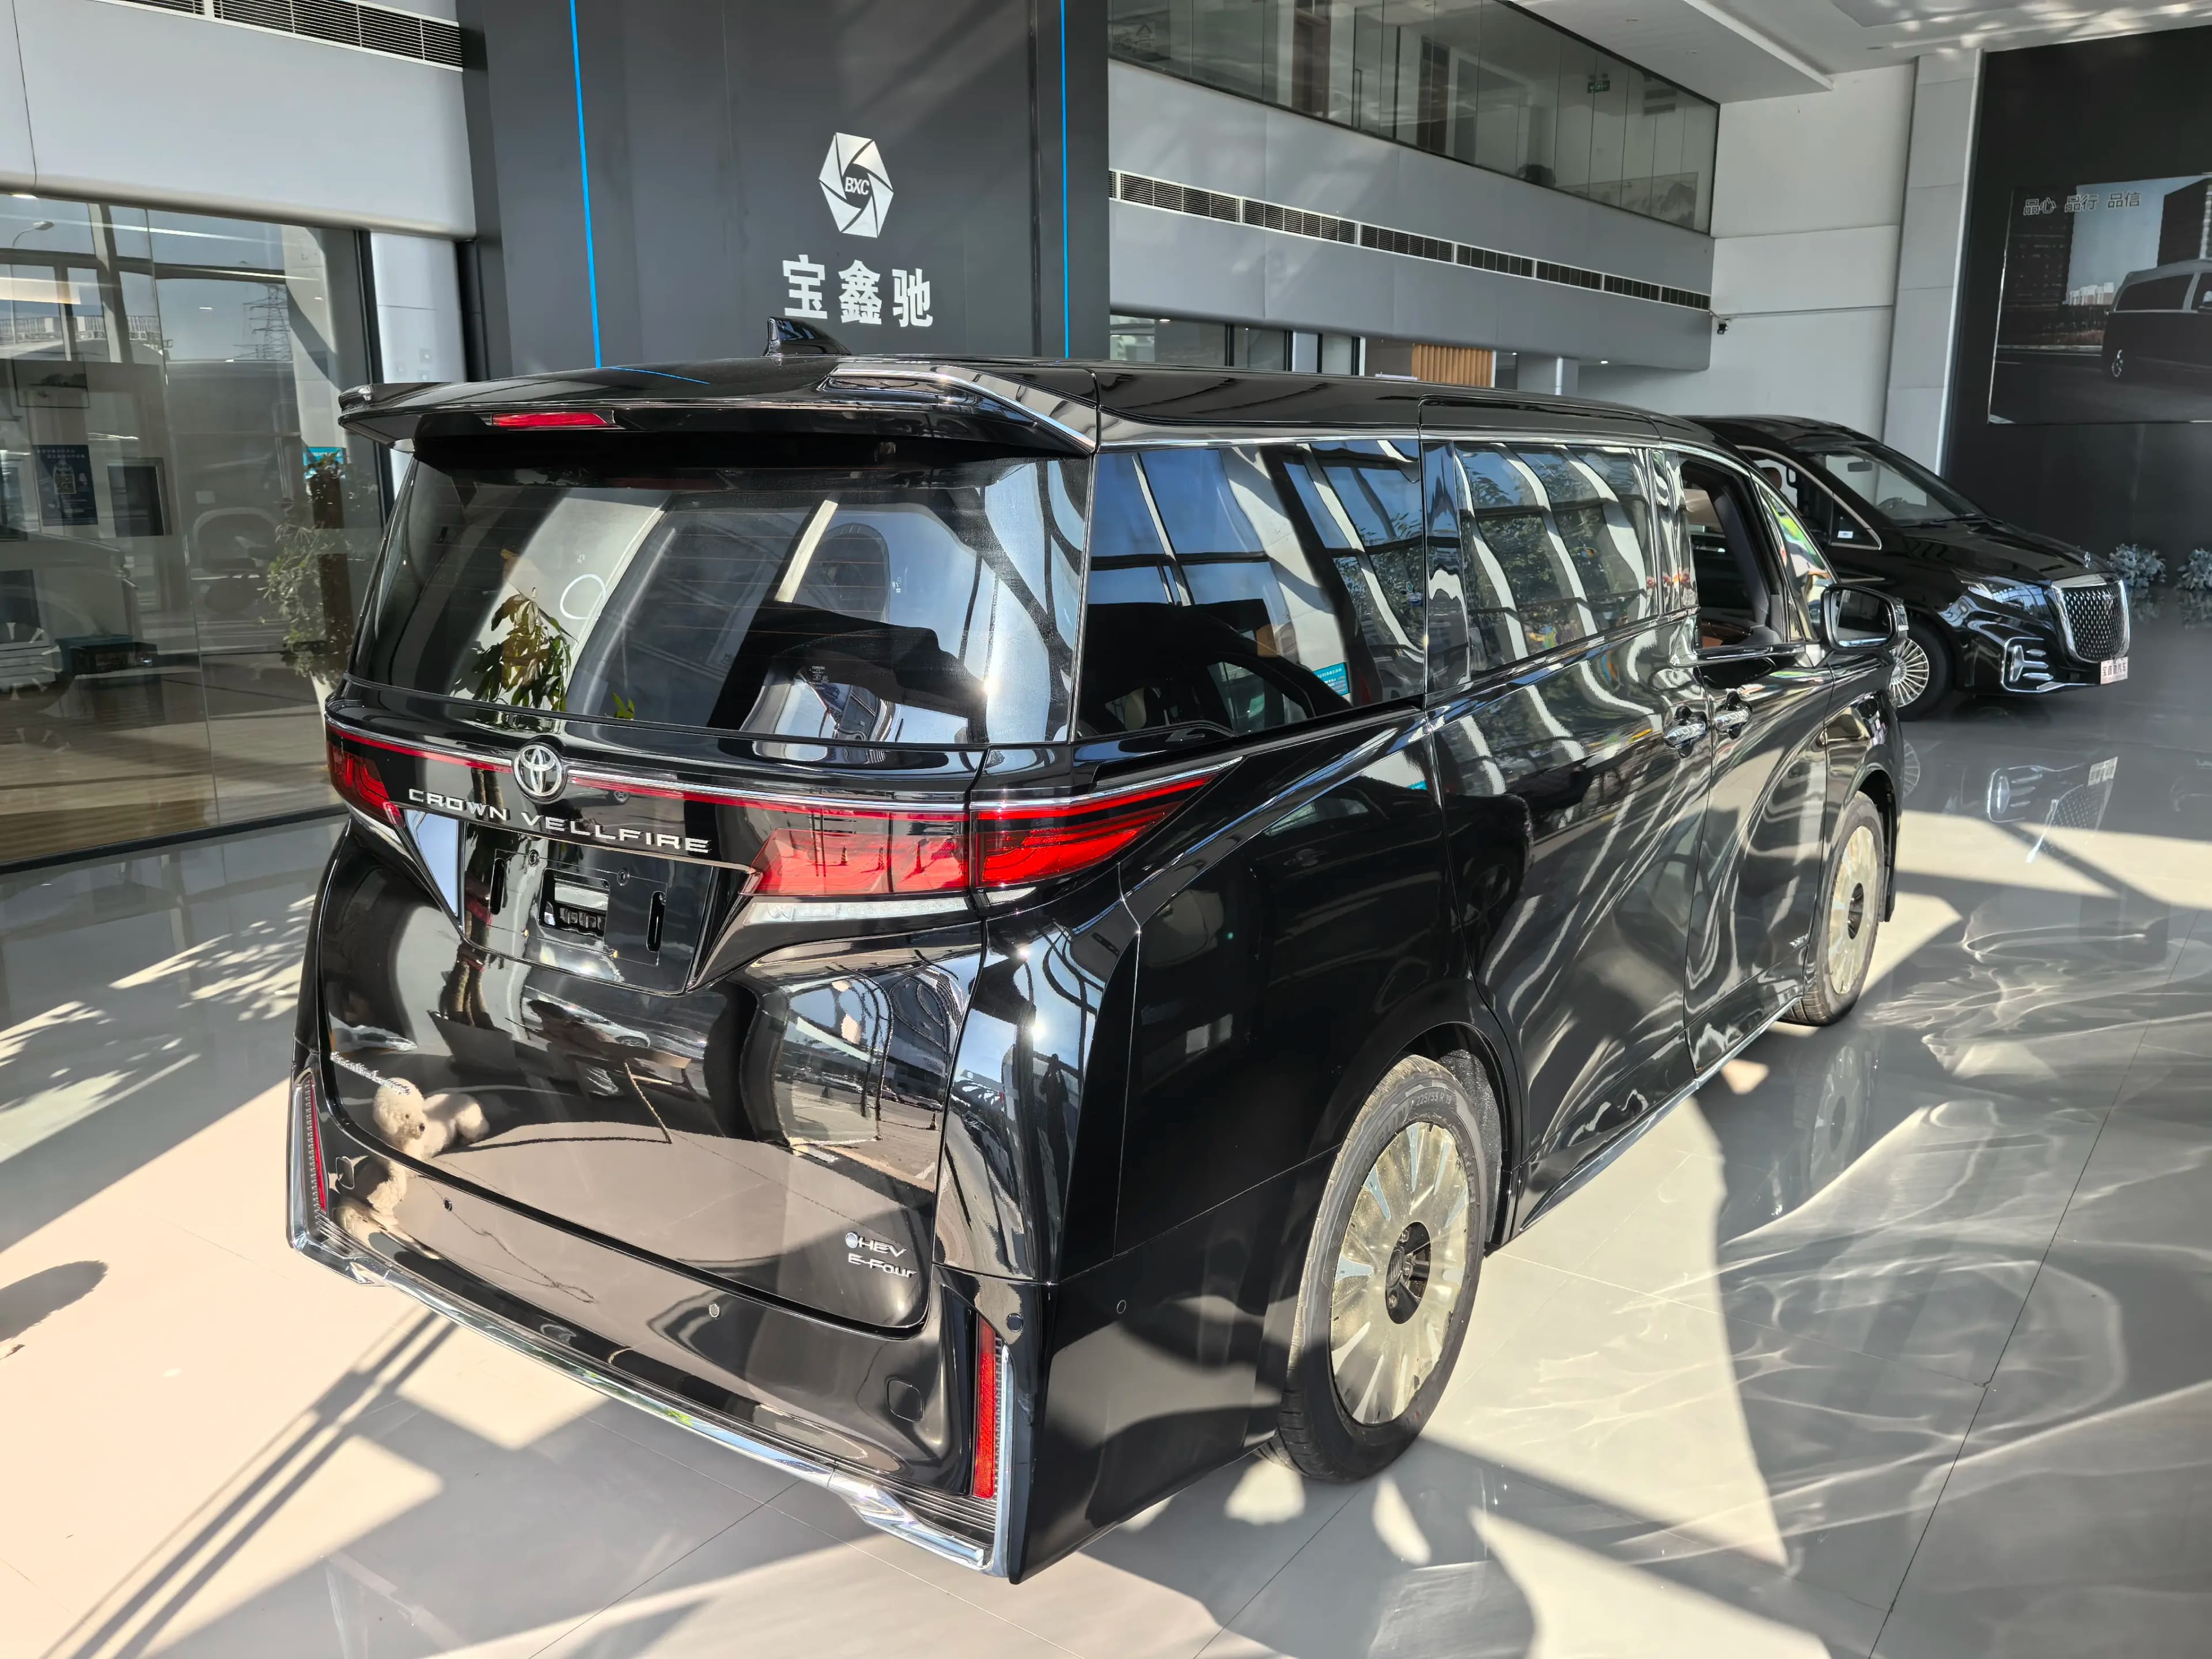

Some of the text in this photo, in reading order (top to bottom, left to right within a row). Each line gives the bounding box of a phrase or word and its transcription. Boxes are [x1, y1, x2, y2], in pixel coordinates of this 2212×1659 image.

[845, 176, 870, 195] BXC
[2023, 191, 2142, 215] 品心 品行 品信
[782, 254, 933, 327] 宝鑫驰
[408, 788, 711, 853] CROWN VELLFIRE
[1416, 1091, 1438, 1107] 225/55
[1445, 1094, 1452, 1105] 19
[858, 1237, 907, 1257] HEV
[848, 1252, 918, 1278] E-Four
